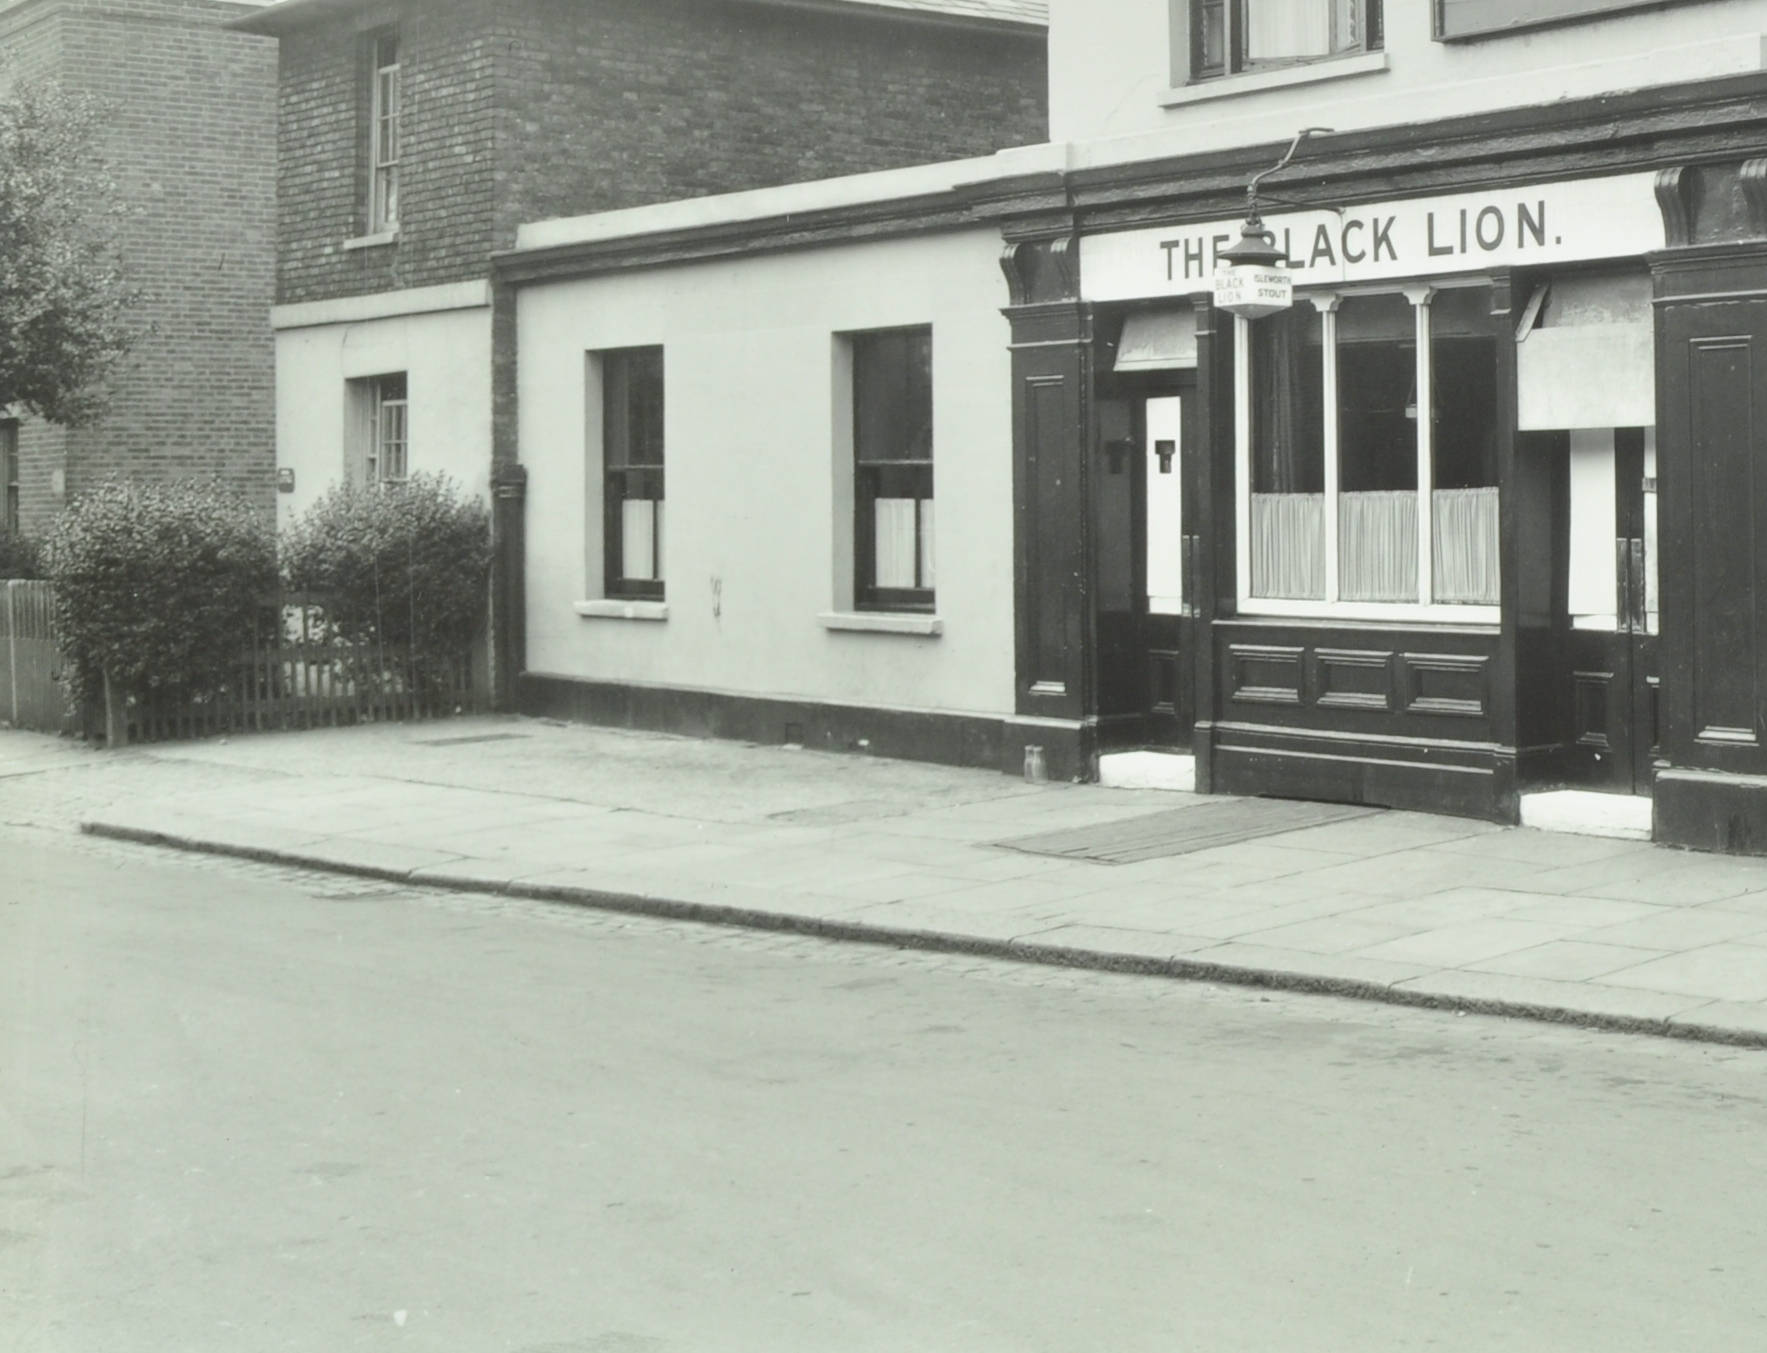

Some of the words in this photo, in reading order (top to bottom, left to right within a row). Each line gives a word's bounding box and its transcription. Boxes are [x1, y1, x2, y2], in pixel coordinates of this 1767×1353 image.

[1262, 216, 1398, 269] LACK
[1427, 200, 1562, 257] LION.
[1215, 277, 1244, 290] BLACK
[1218, 291, 1242, 303] LION
[1258, 288, 1286, 299] STOUT
